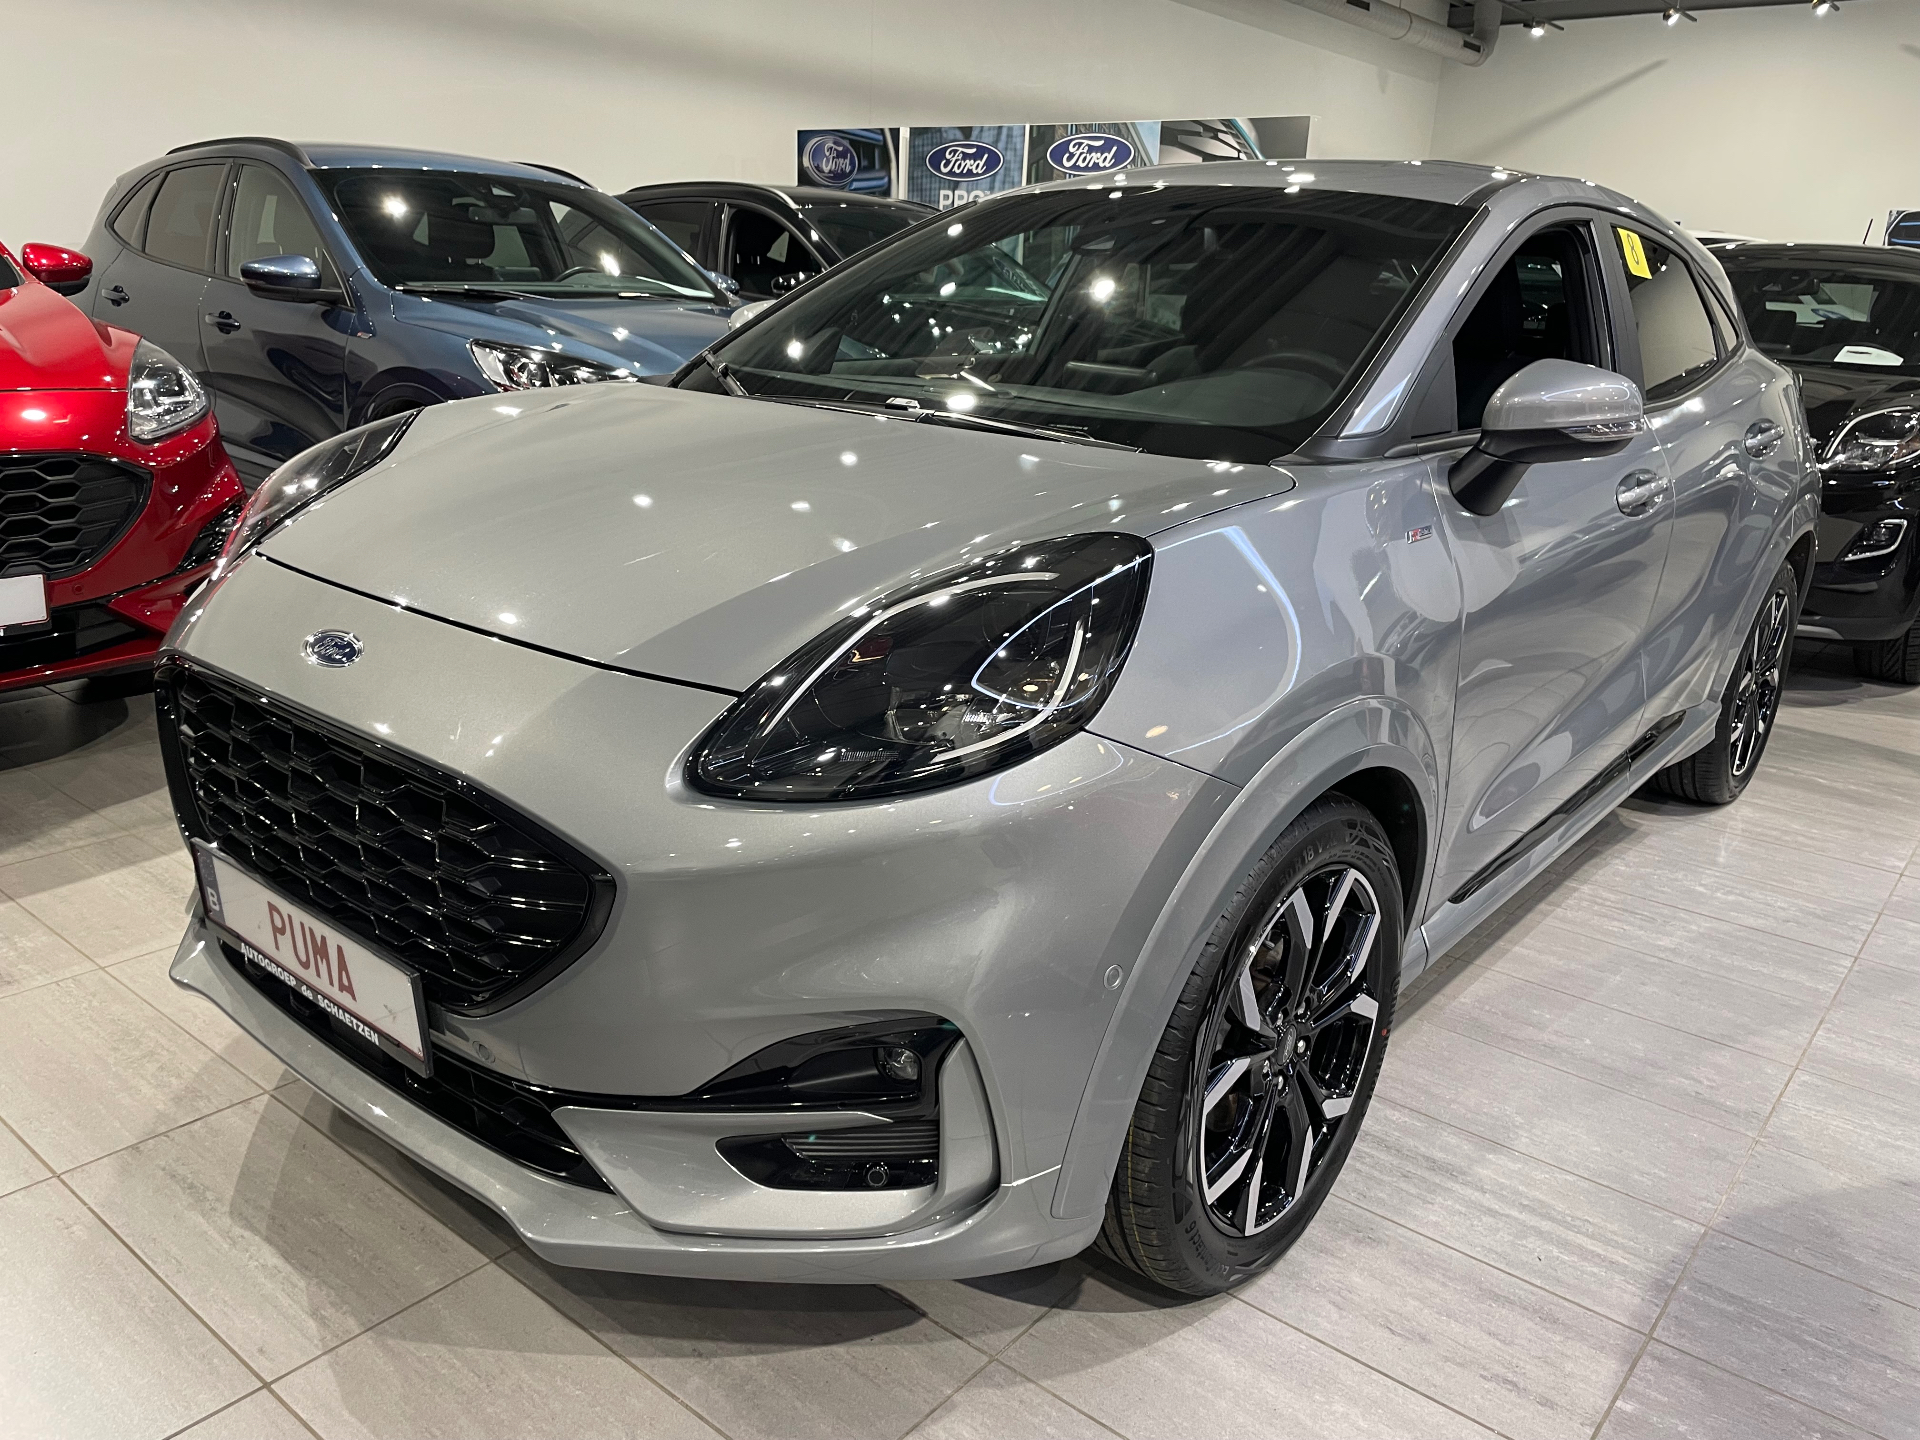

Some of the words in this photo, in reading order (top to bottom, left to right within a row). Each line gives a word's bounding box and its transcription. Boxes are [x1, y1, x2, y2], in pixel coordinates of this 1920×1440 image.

[822, 143, 851, 174] Ford
[940, 146, 989, 175] Ford
[1062, 139, 1118, 168] Ford
[206, 885, 220, 912] B
[267, 900, 358, 1003] PUMA
[240, 942, 297, 987] AUTOGROEP
[301, 984, 314, 1001] de
[317, 993, 380, 1047] SCHAETZEN
